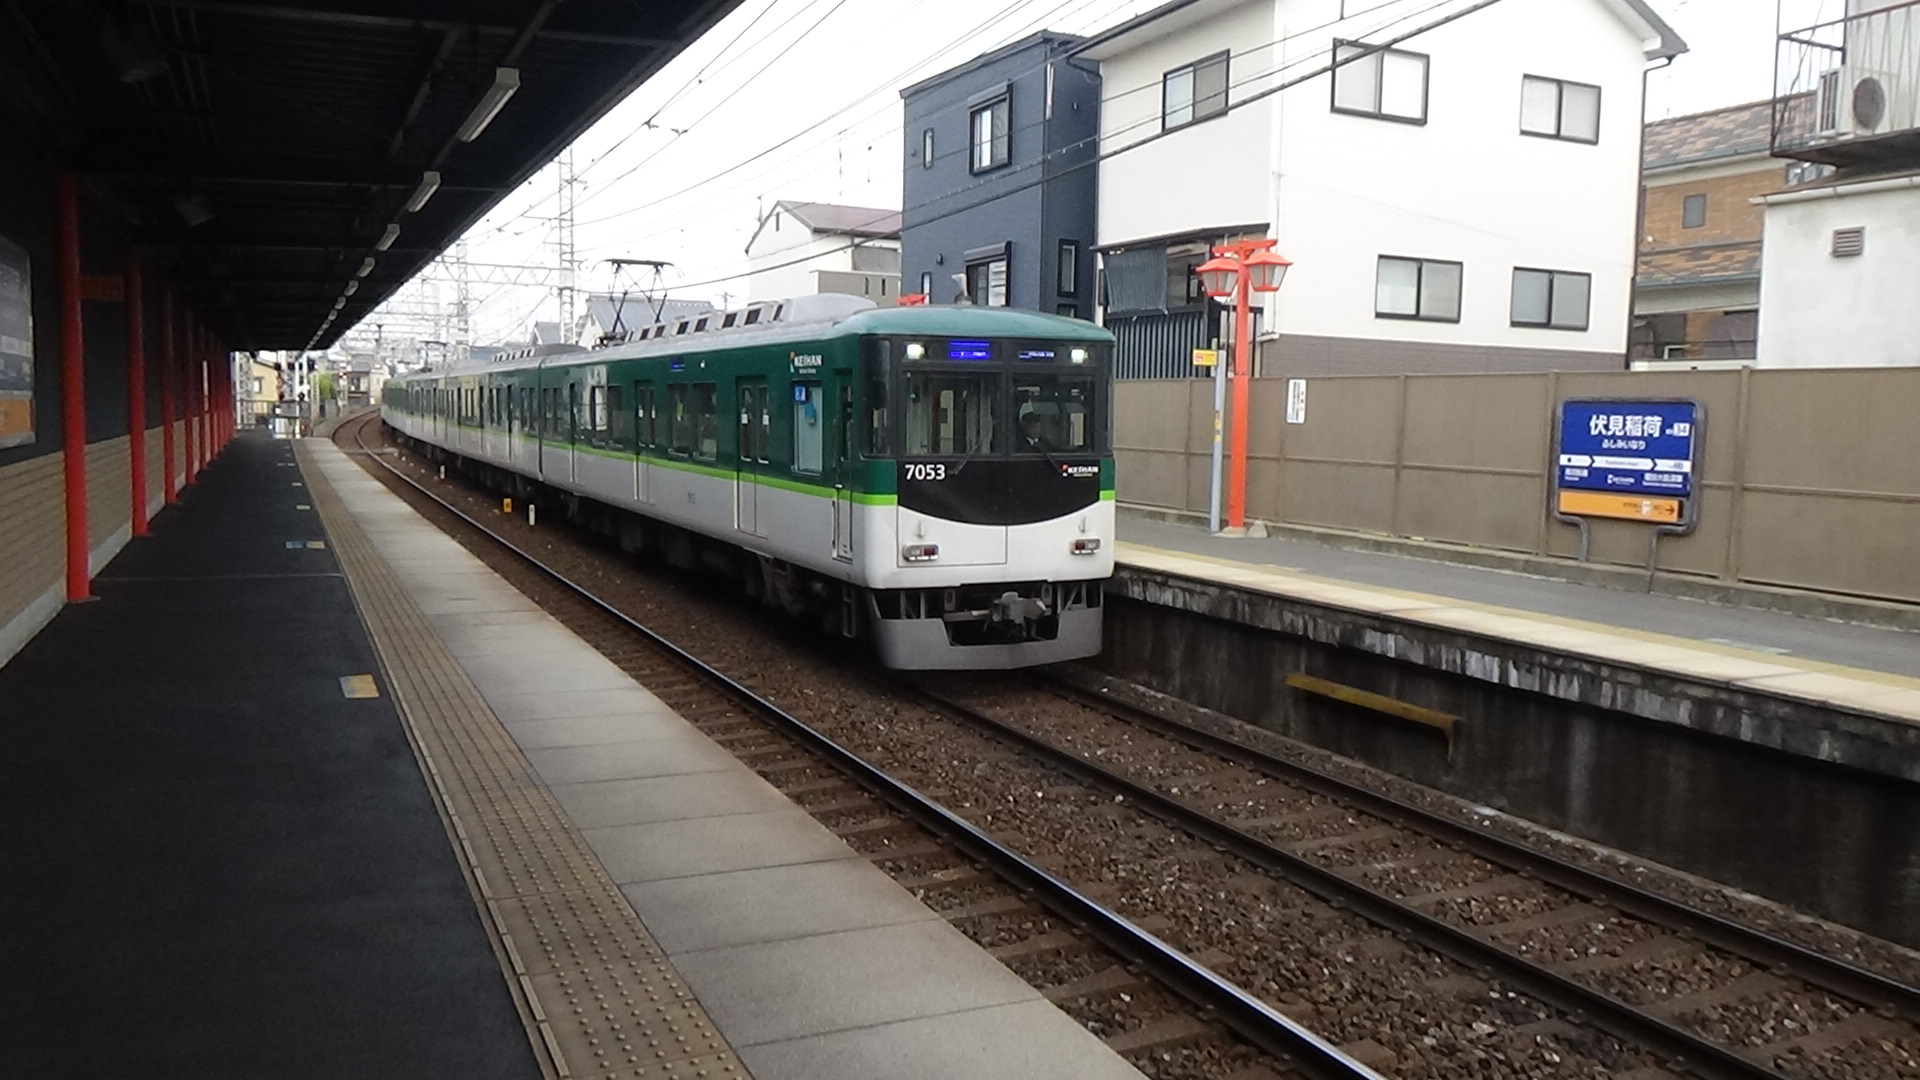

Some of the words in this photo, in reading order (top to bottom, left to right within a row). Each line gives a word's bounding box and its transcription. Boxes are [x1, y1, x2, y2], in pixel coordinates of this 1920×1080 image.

[794, 354, 822, 367] KEIHAN
[1589, 414, 1663, 437] 伏見稲荷
[1601, 438, 1647, 450] ふしみいなり
[904, 464, 946, 480] 7053
